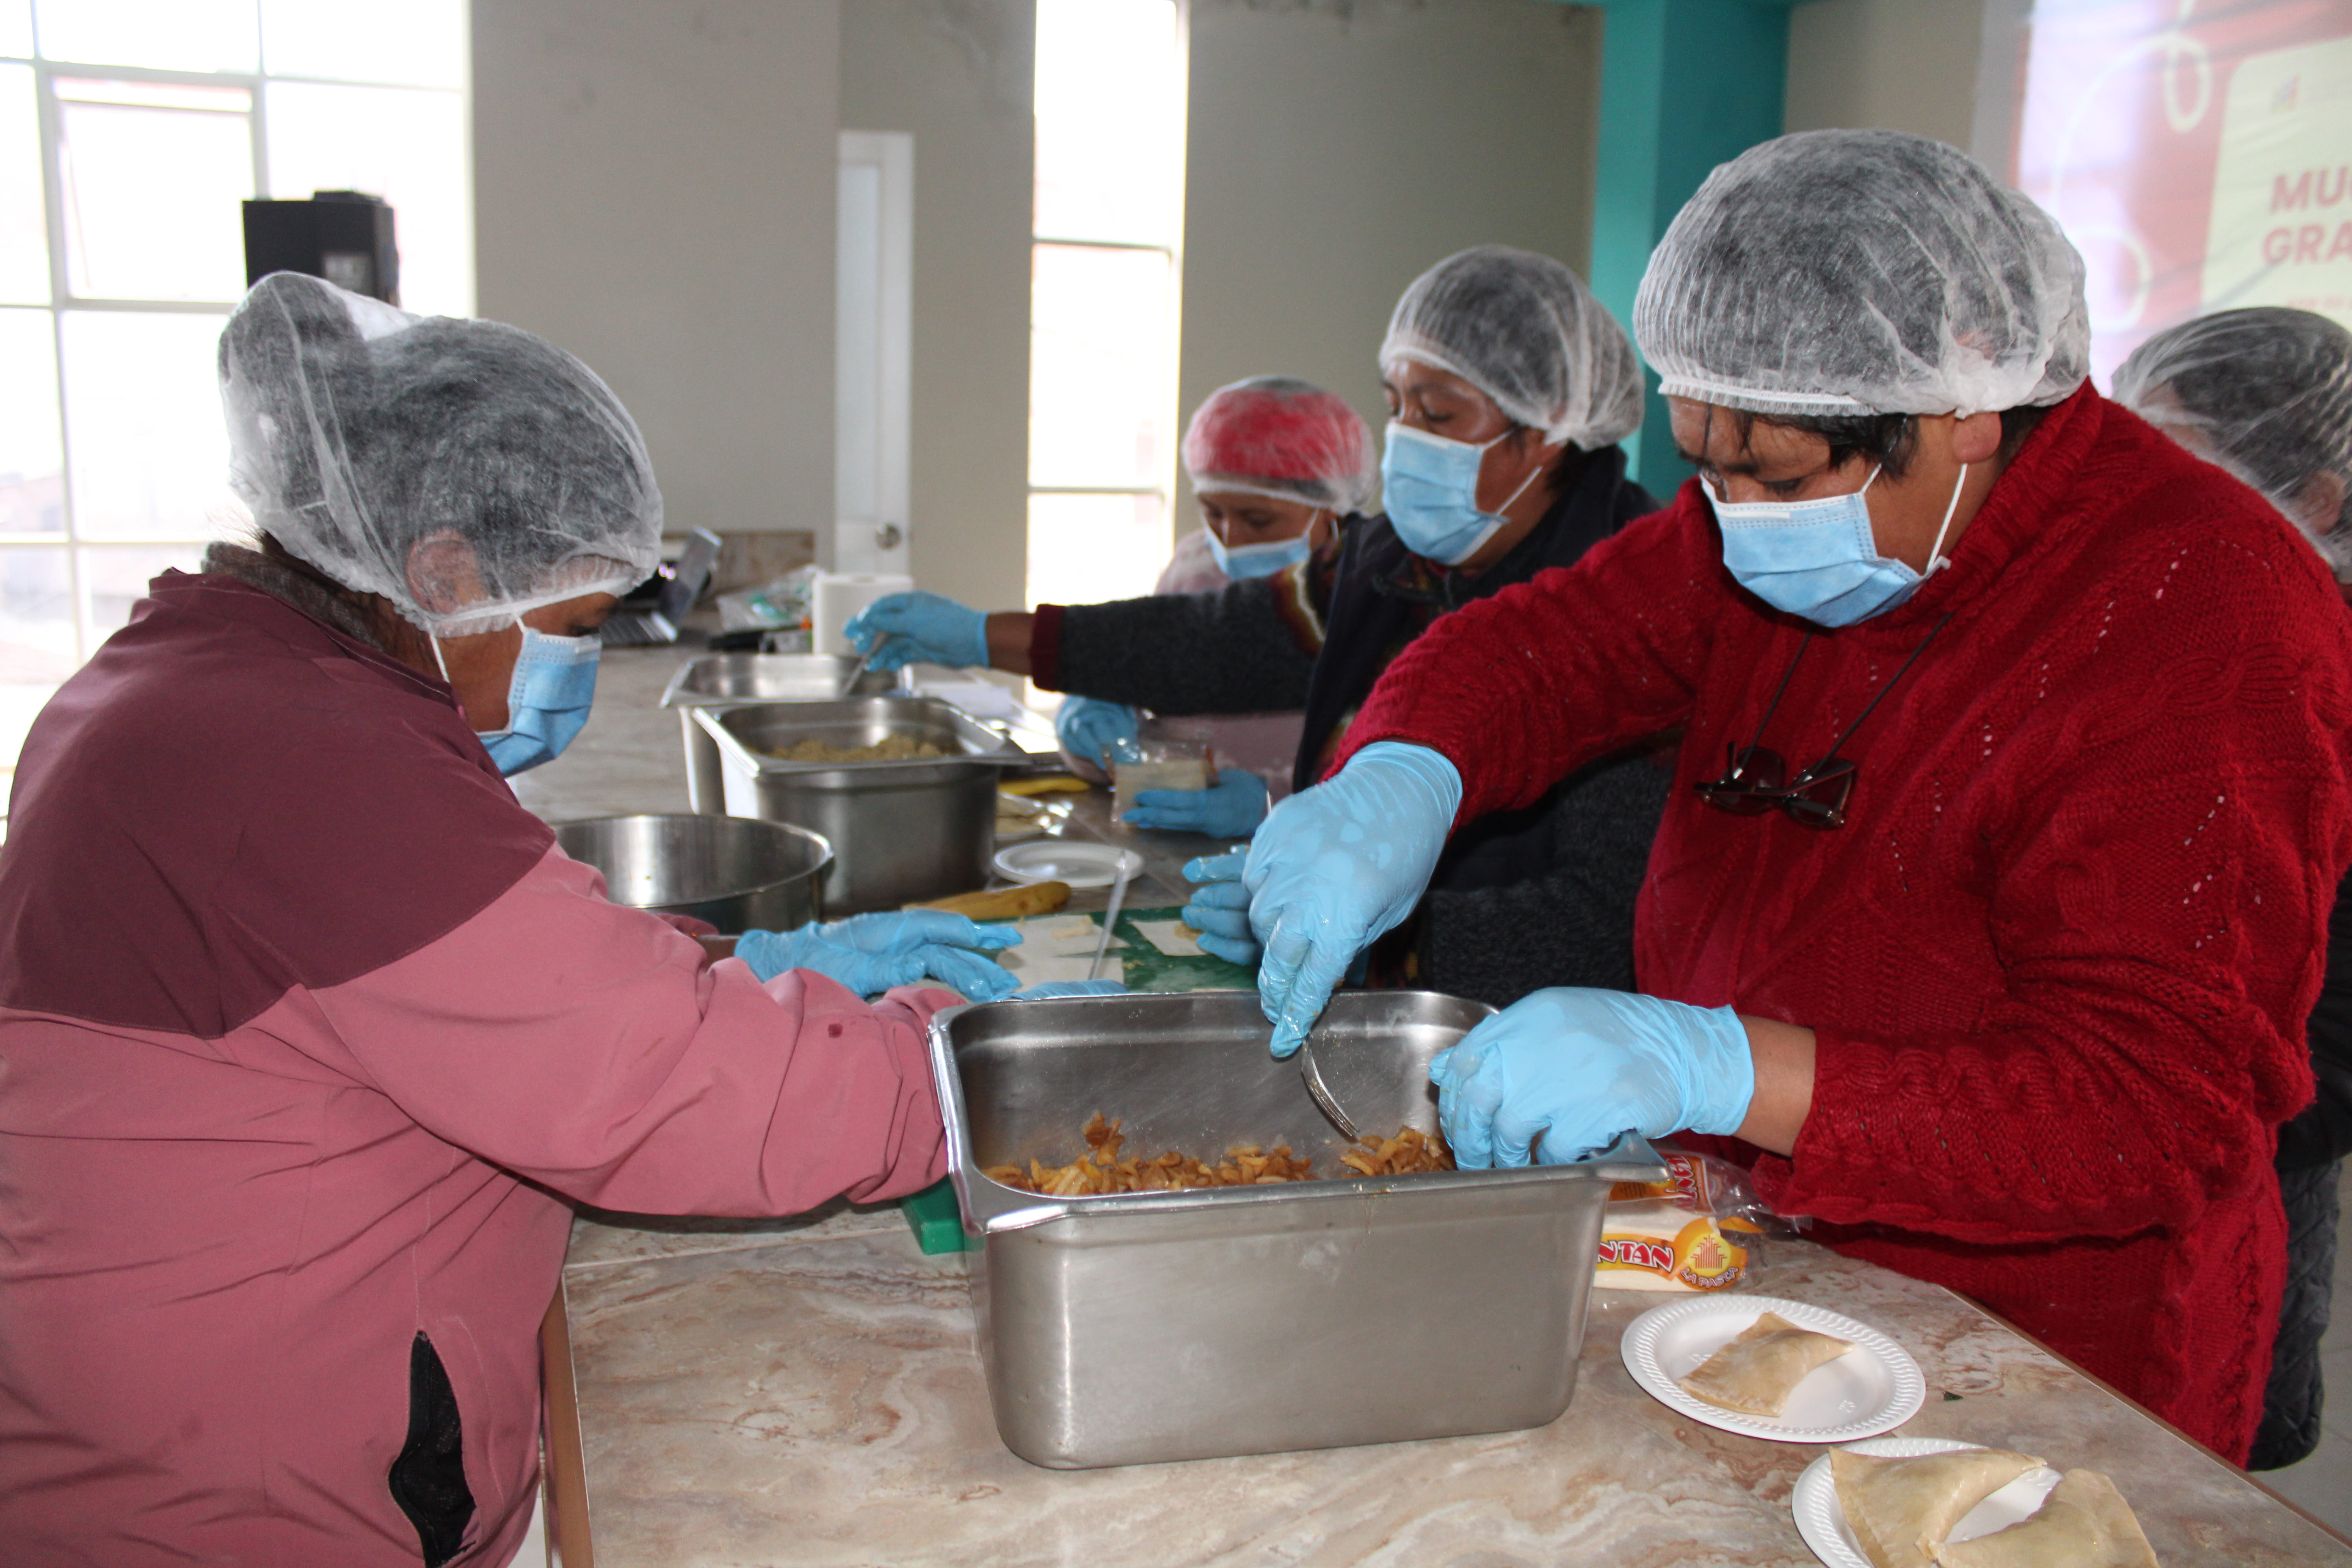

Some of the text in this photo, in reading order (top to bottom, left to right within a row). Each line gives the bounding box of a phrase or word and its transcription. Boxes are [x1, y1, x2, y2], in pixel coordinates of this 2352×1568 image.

[2271, 166, 2352, 213] MU
[1681, 1267, 1739, 1289] LA PASTA
